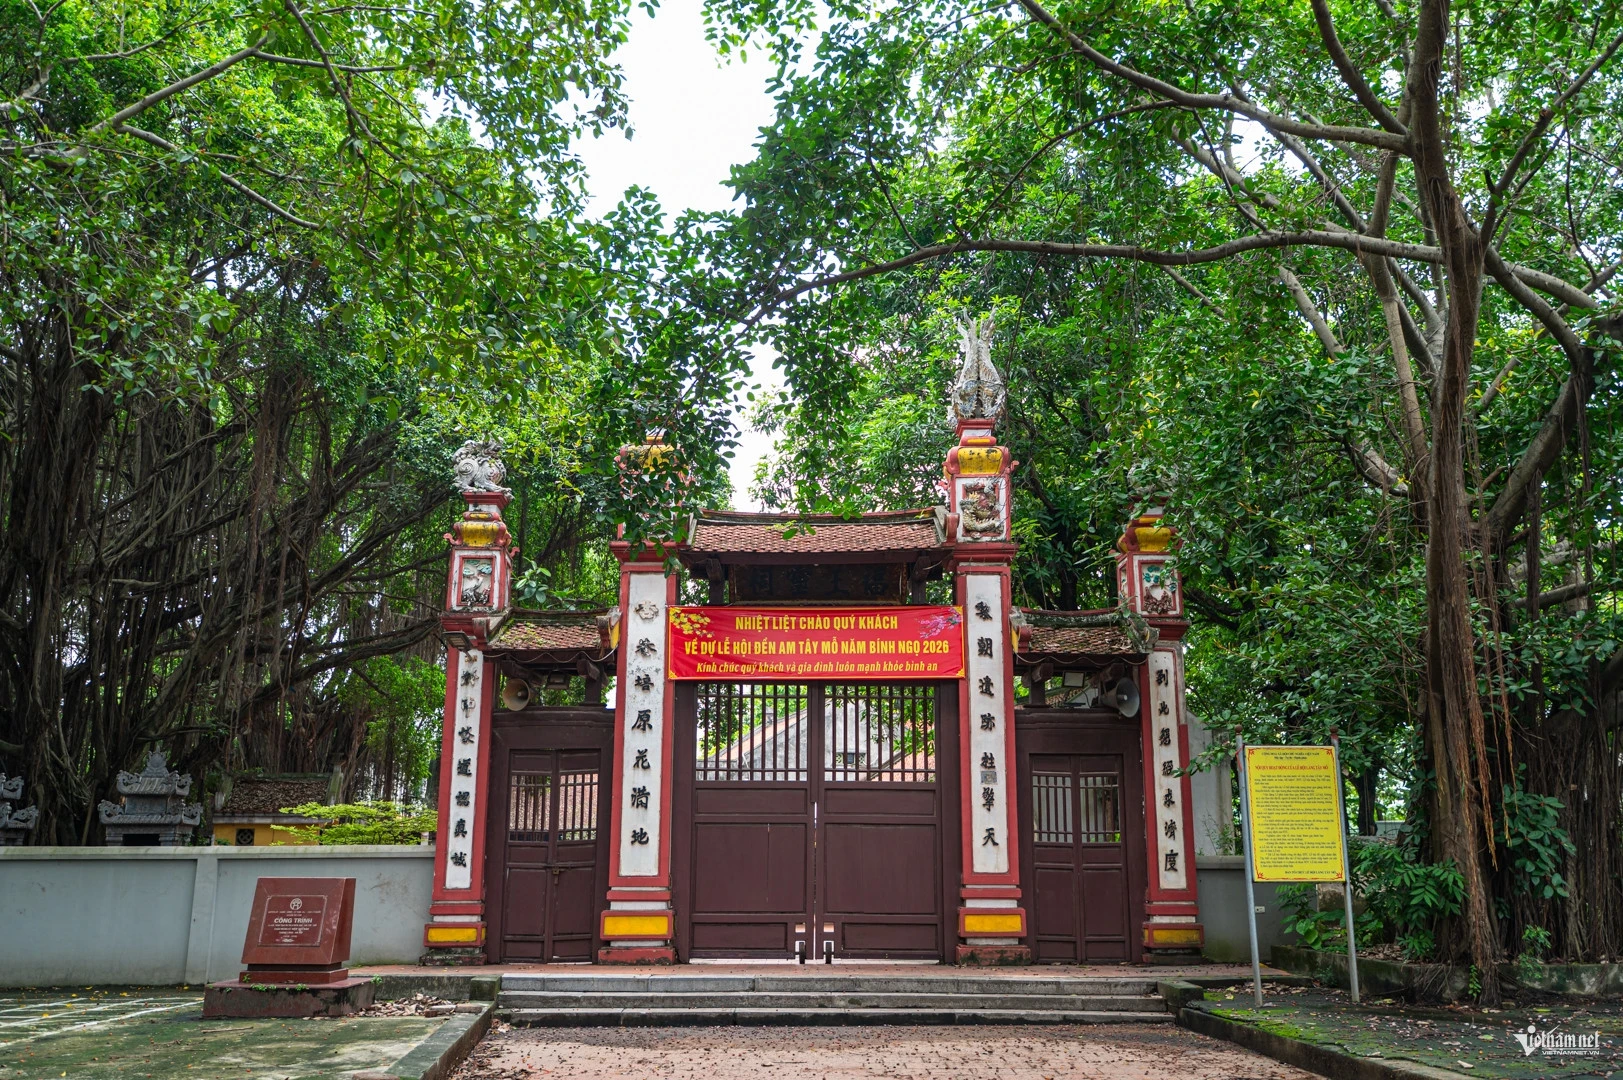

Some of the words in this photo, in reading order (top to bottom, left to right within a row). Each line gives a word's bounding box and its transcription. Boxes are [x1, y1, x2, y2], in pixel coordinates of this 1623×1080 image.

[735, 614, 770, 632] NHIỆT
[772, 614, 796, 632] LIỆT
[799, 614, 830, 630] CHÀO
[834, 614, 856, 631] QUÝ
[858, 614, 898, 630] KHÁCH
[700, 640, 716, 658] DỰ
[718, 636, 730, 654] LỄ
[732, 639, 752, 657] HỘI
[778, 641, 796, 654] AM
[798, 638, 818, 654] TÂY
[822, 636, 838, 654] MỖ
[841, 638, 866, 654] NĂM
[870, 638, 896, 654] BÍNH
[898, 640, 920, 656] NGỌ
[922, 640, 949, 654] 2026
[696, 662, 717, 672] Kính
[718, 662, 740, 672] chúc
[740, 661, 758, 674] quý
[758, 661, 784, 672] khách
[786, 662, 796, 672] và
[798, 662, 812, 674] gia
[814, 662, 834, 672] đình
[836, 660, 855, 672] luôn
[857, 661, 880, 674] mạnh
[882, 660, 904, 672] khỏe
[906, 660, 925, 672] bình
[927, 663, 938, 671] an
